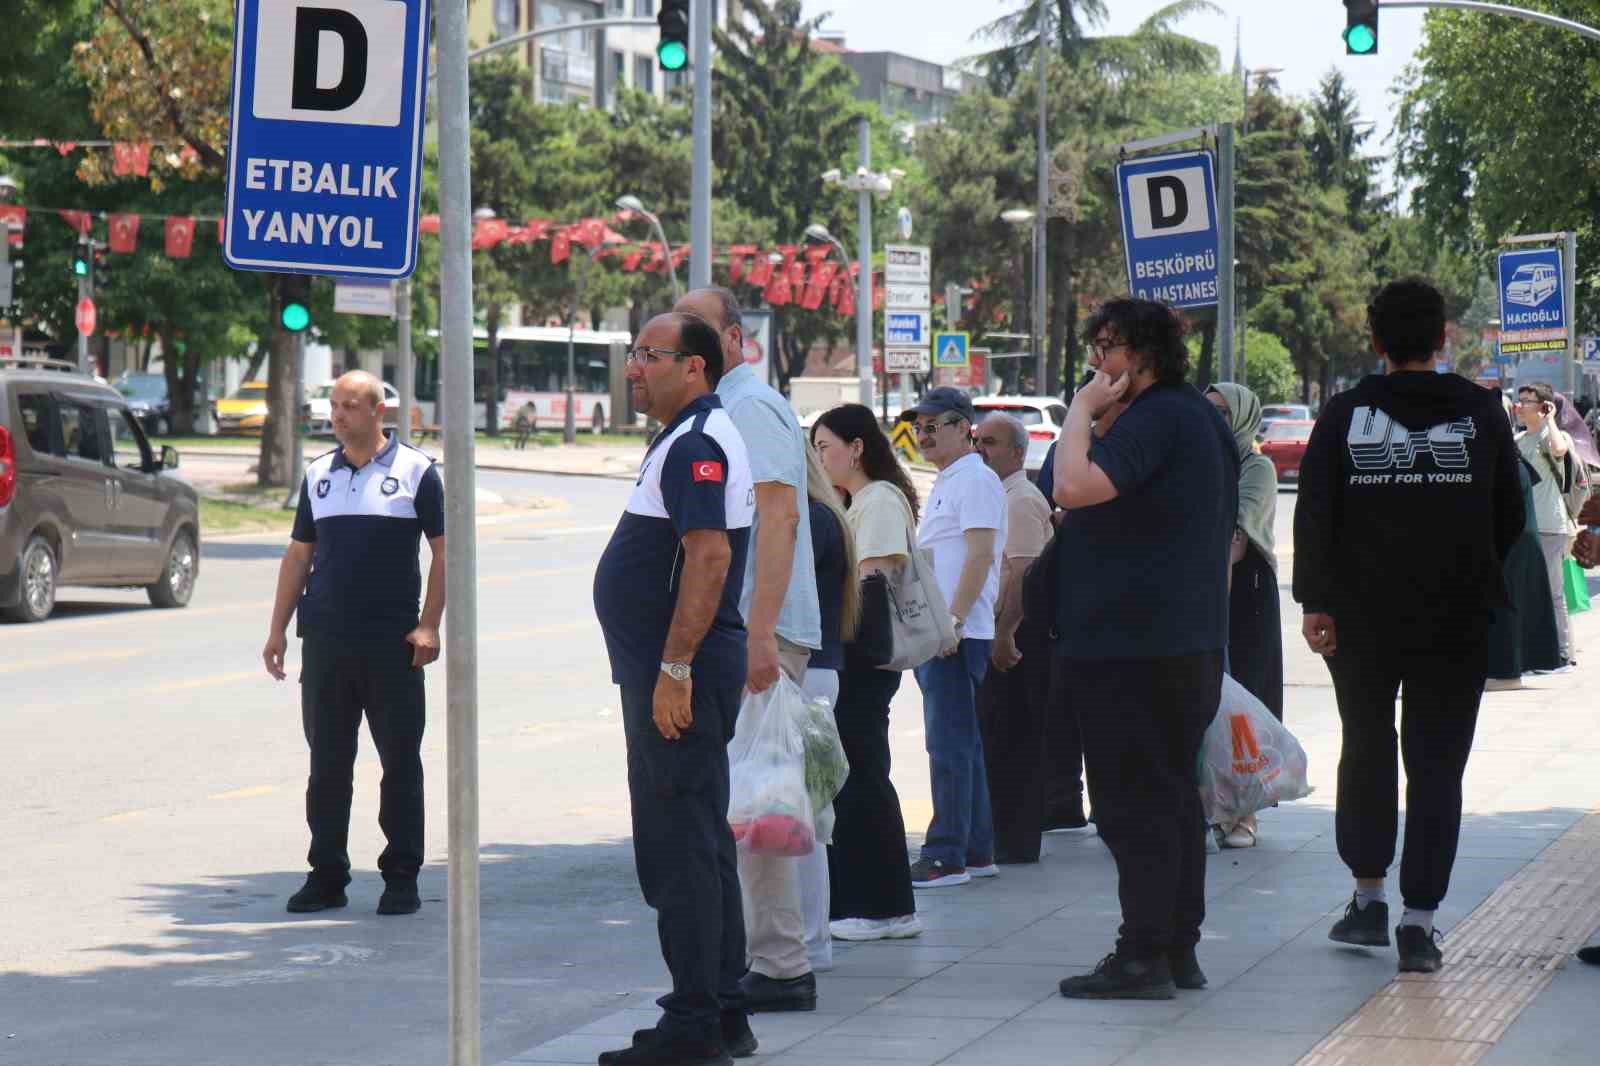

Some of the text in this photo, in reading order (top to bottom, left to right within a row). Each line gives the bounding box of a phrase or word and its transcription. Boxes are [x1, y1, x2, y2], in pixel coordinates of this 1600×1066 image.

[291, 6, 368, 111] D
[245, 157, 399, 198] ETBALIK
[1146, 175, 1189, 230] D
[242, 208, 383, 249] YANYOL
[1135, 249, 1216, 279] BEŞKÖPRÜ
[1506, 309, 1560, 325] HACIOĞLU
[1349, 473, 1473, 485] FIGHT FOR YOURS
